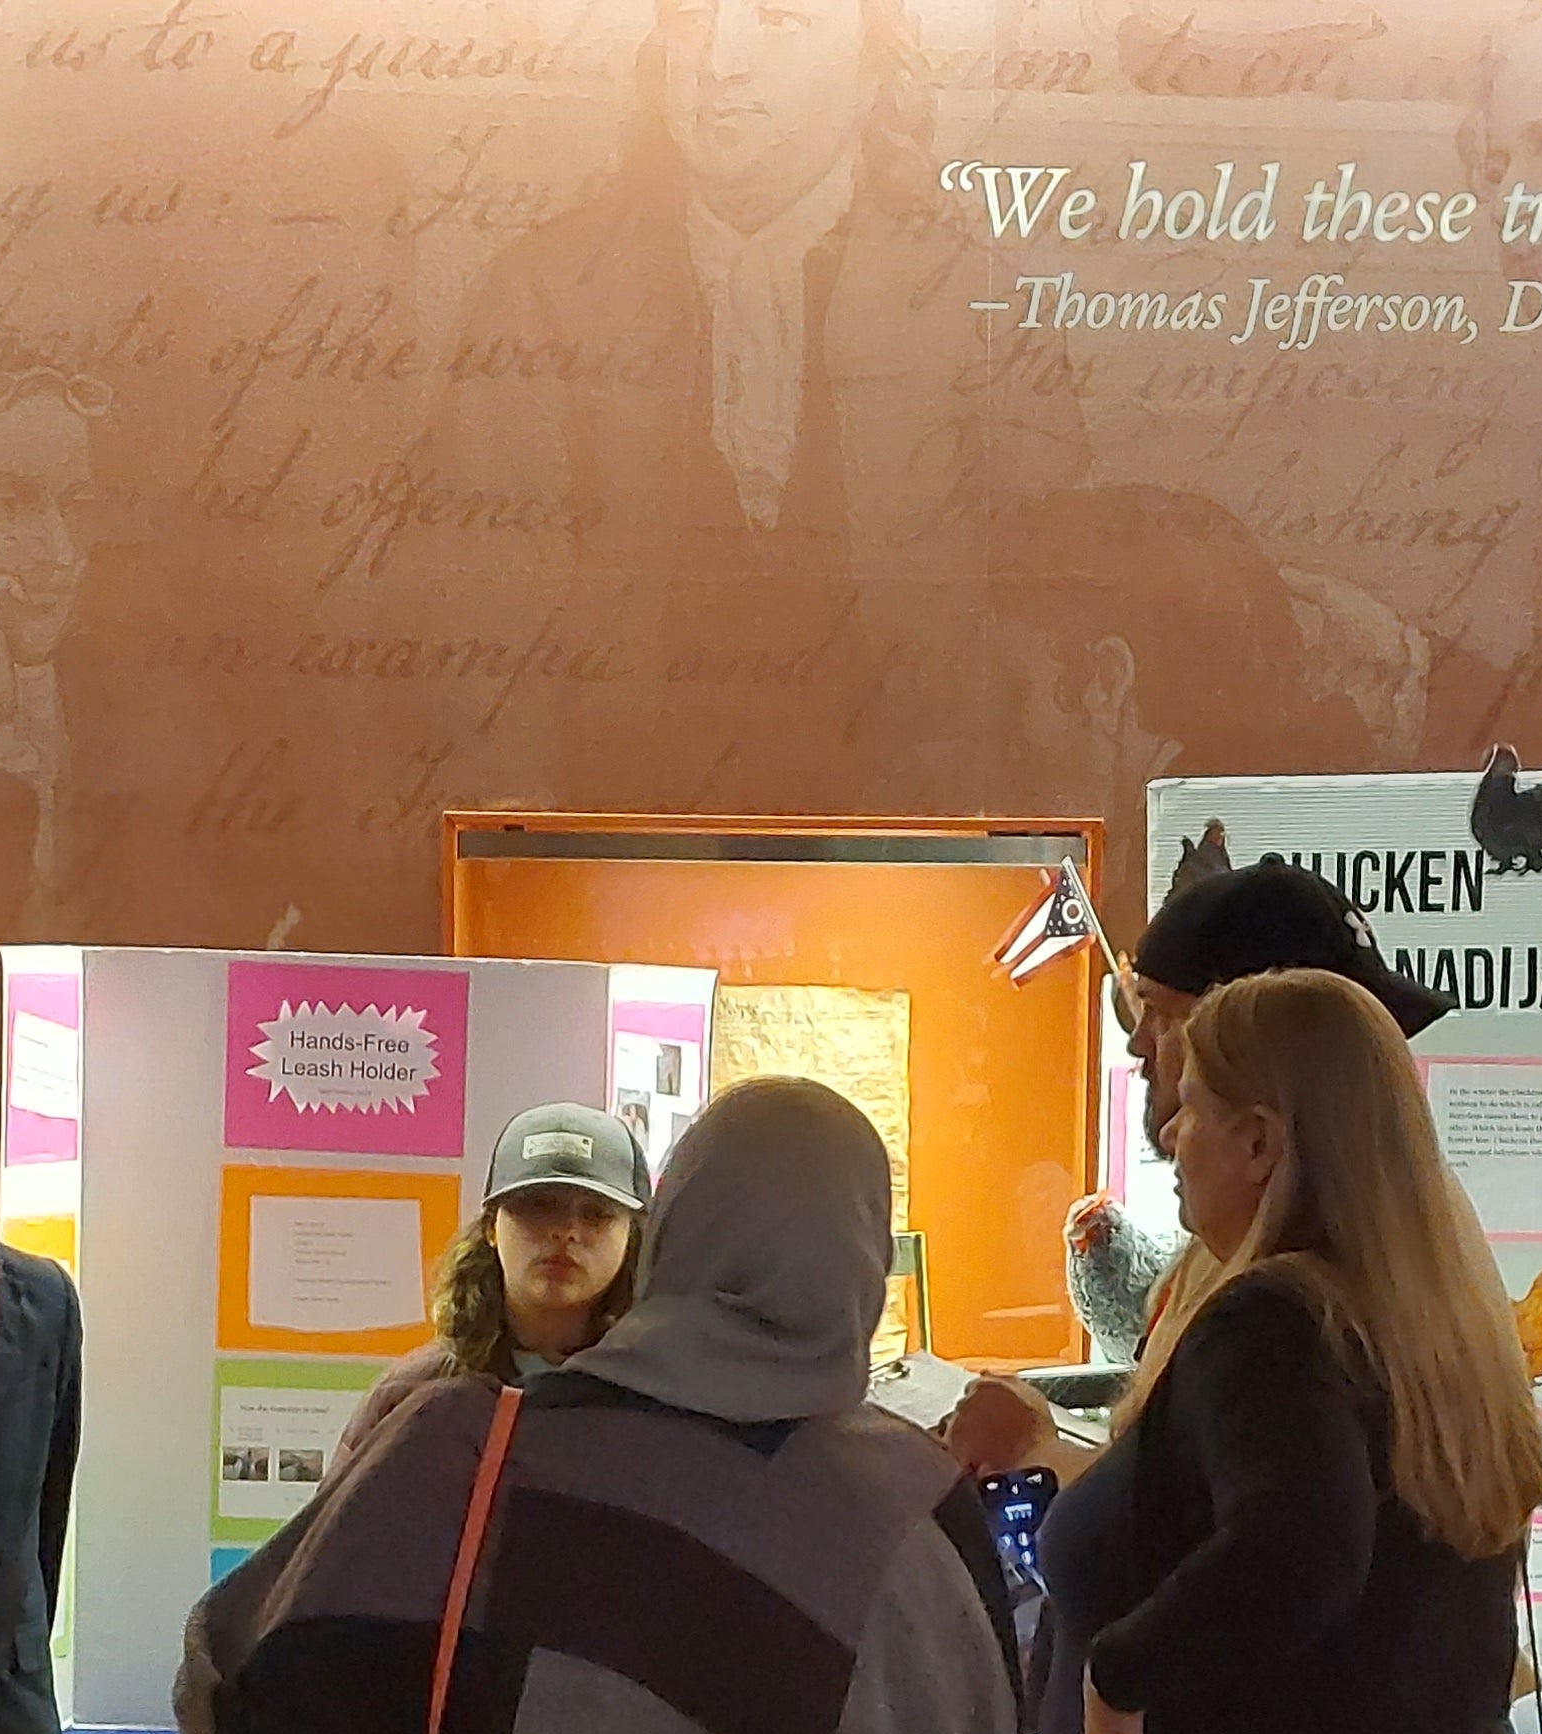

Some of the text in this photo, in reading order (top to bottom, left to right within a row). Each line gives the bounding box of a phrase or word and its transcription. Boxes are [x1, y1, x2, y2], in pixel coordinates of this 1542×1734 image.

[1119, 161, 1279, 244] hold
[1301, 163, 1477, 246] these
[1233, 274, 1482, 352] Jefferson,
[1260, 848, 1484, 913] ICKEN
[281, 1058, 418, 1082] Leash Holder
[290, 1030, 411, 1054] Hands-Free
